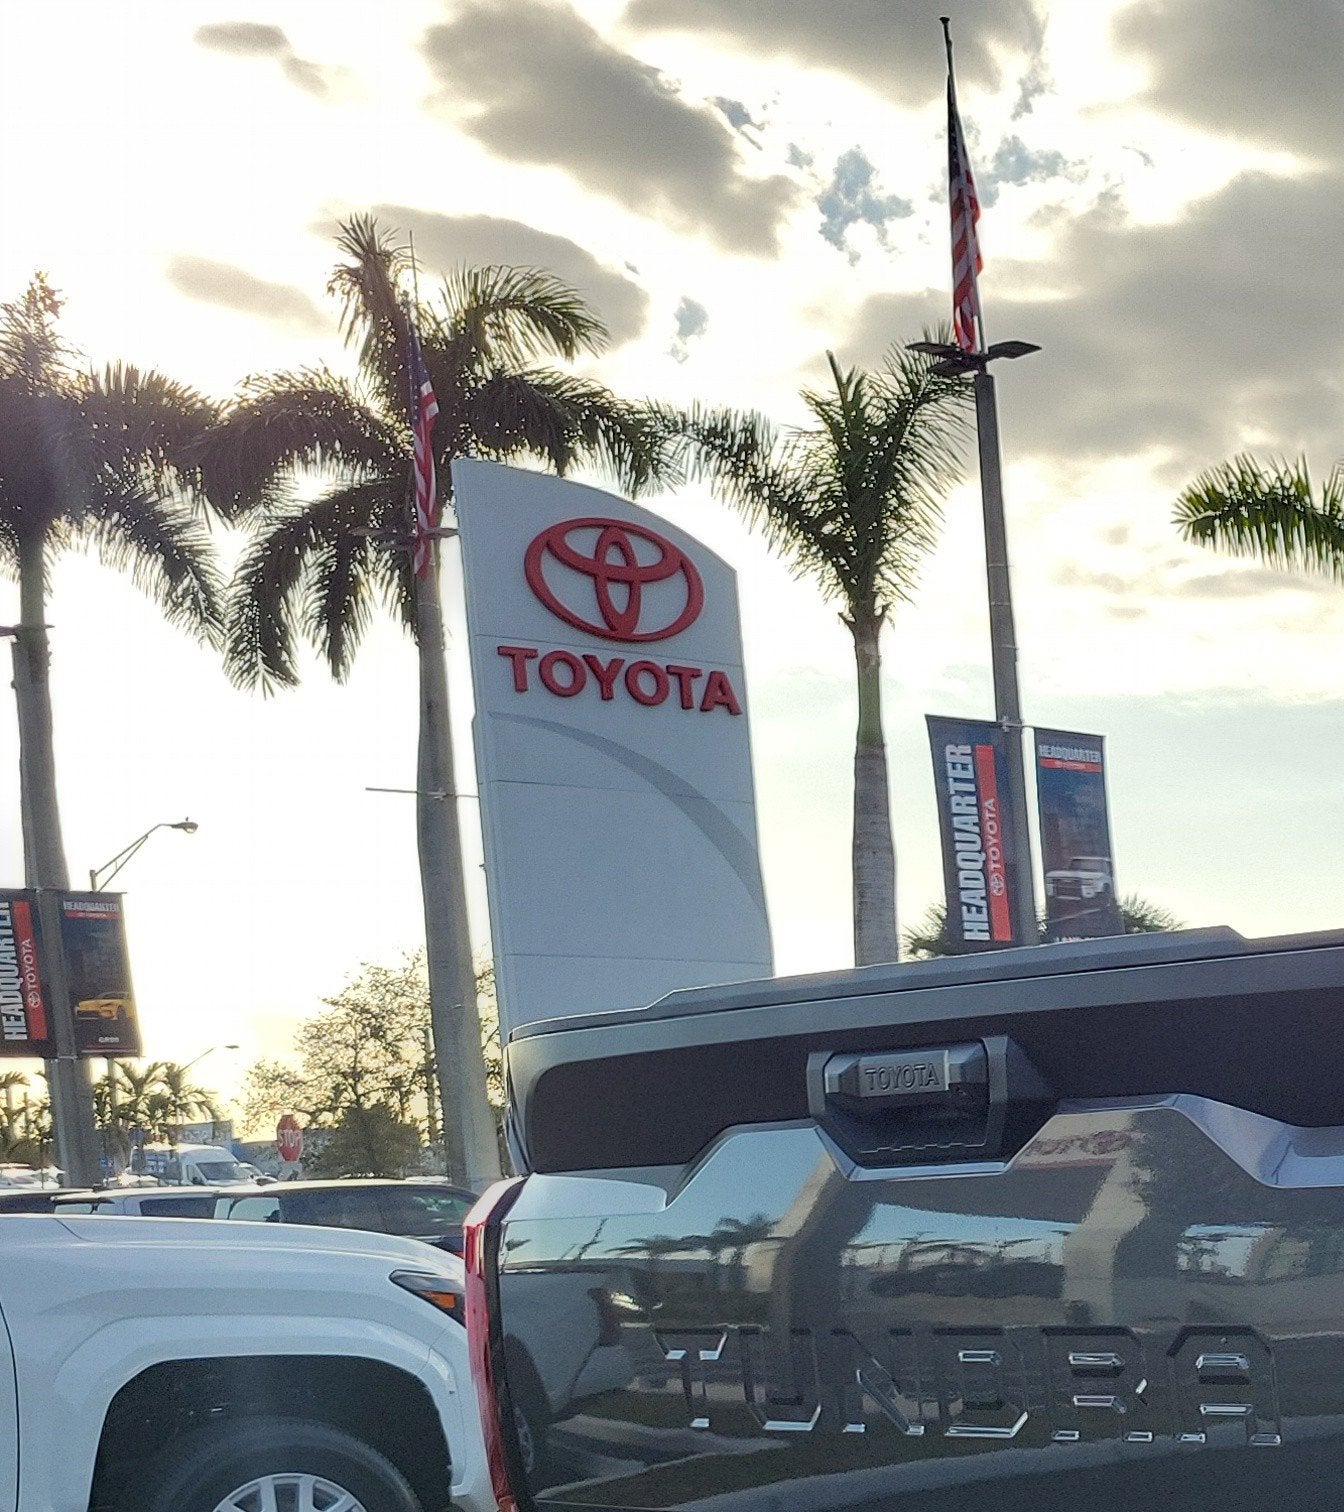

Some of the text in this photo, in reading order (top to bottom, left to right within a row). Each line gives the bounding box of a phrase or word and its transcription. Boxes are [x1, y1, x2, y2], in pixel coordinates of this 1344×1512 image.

[498, 645, 742, 716] TOYOTA
[945, 744, 991, 941] HEADQUARTER
[982, 798, 1004, 870] TOYOTA
[21, 938, 37, 991] TOYOTA
[865, 1063, 940, 1091] TOYOTA
[279, 1129, 302, 1148] STOP
[653, 1325, 1282, 1447] TUNDRA
